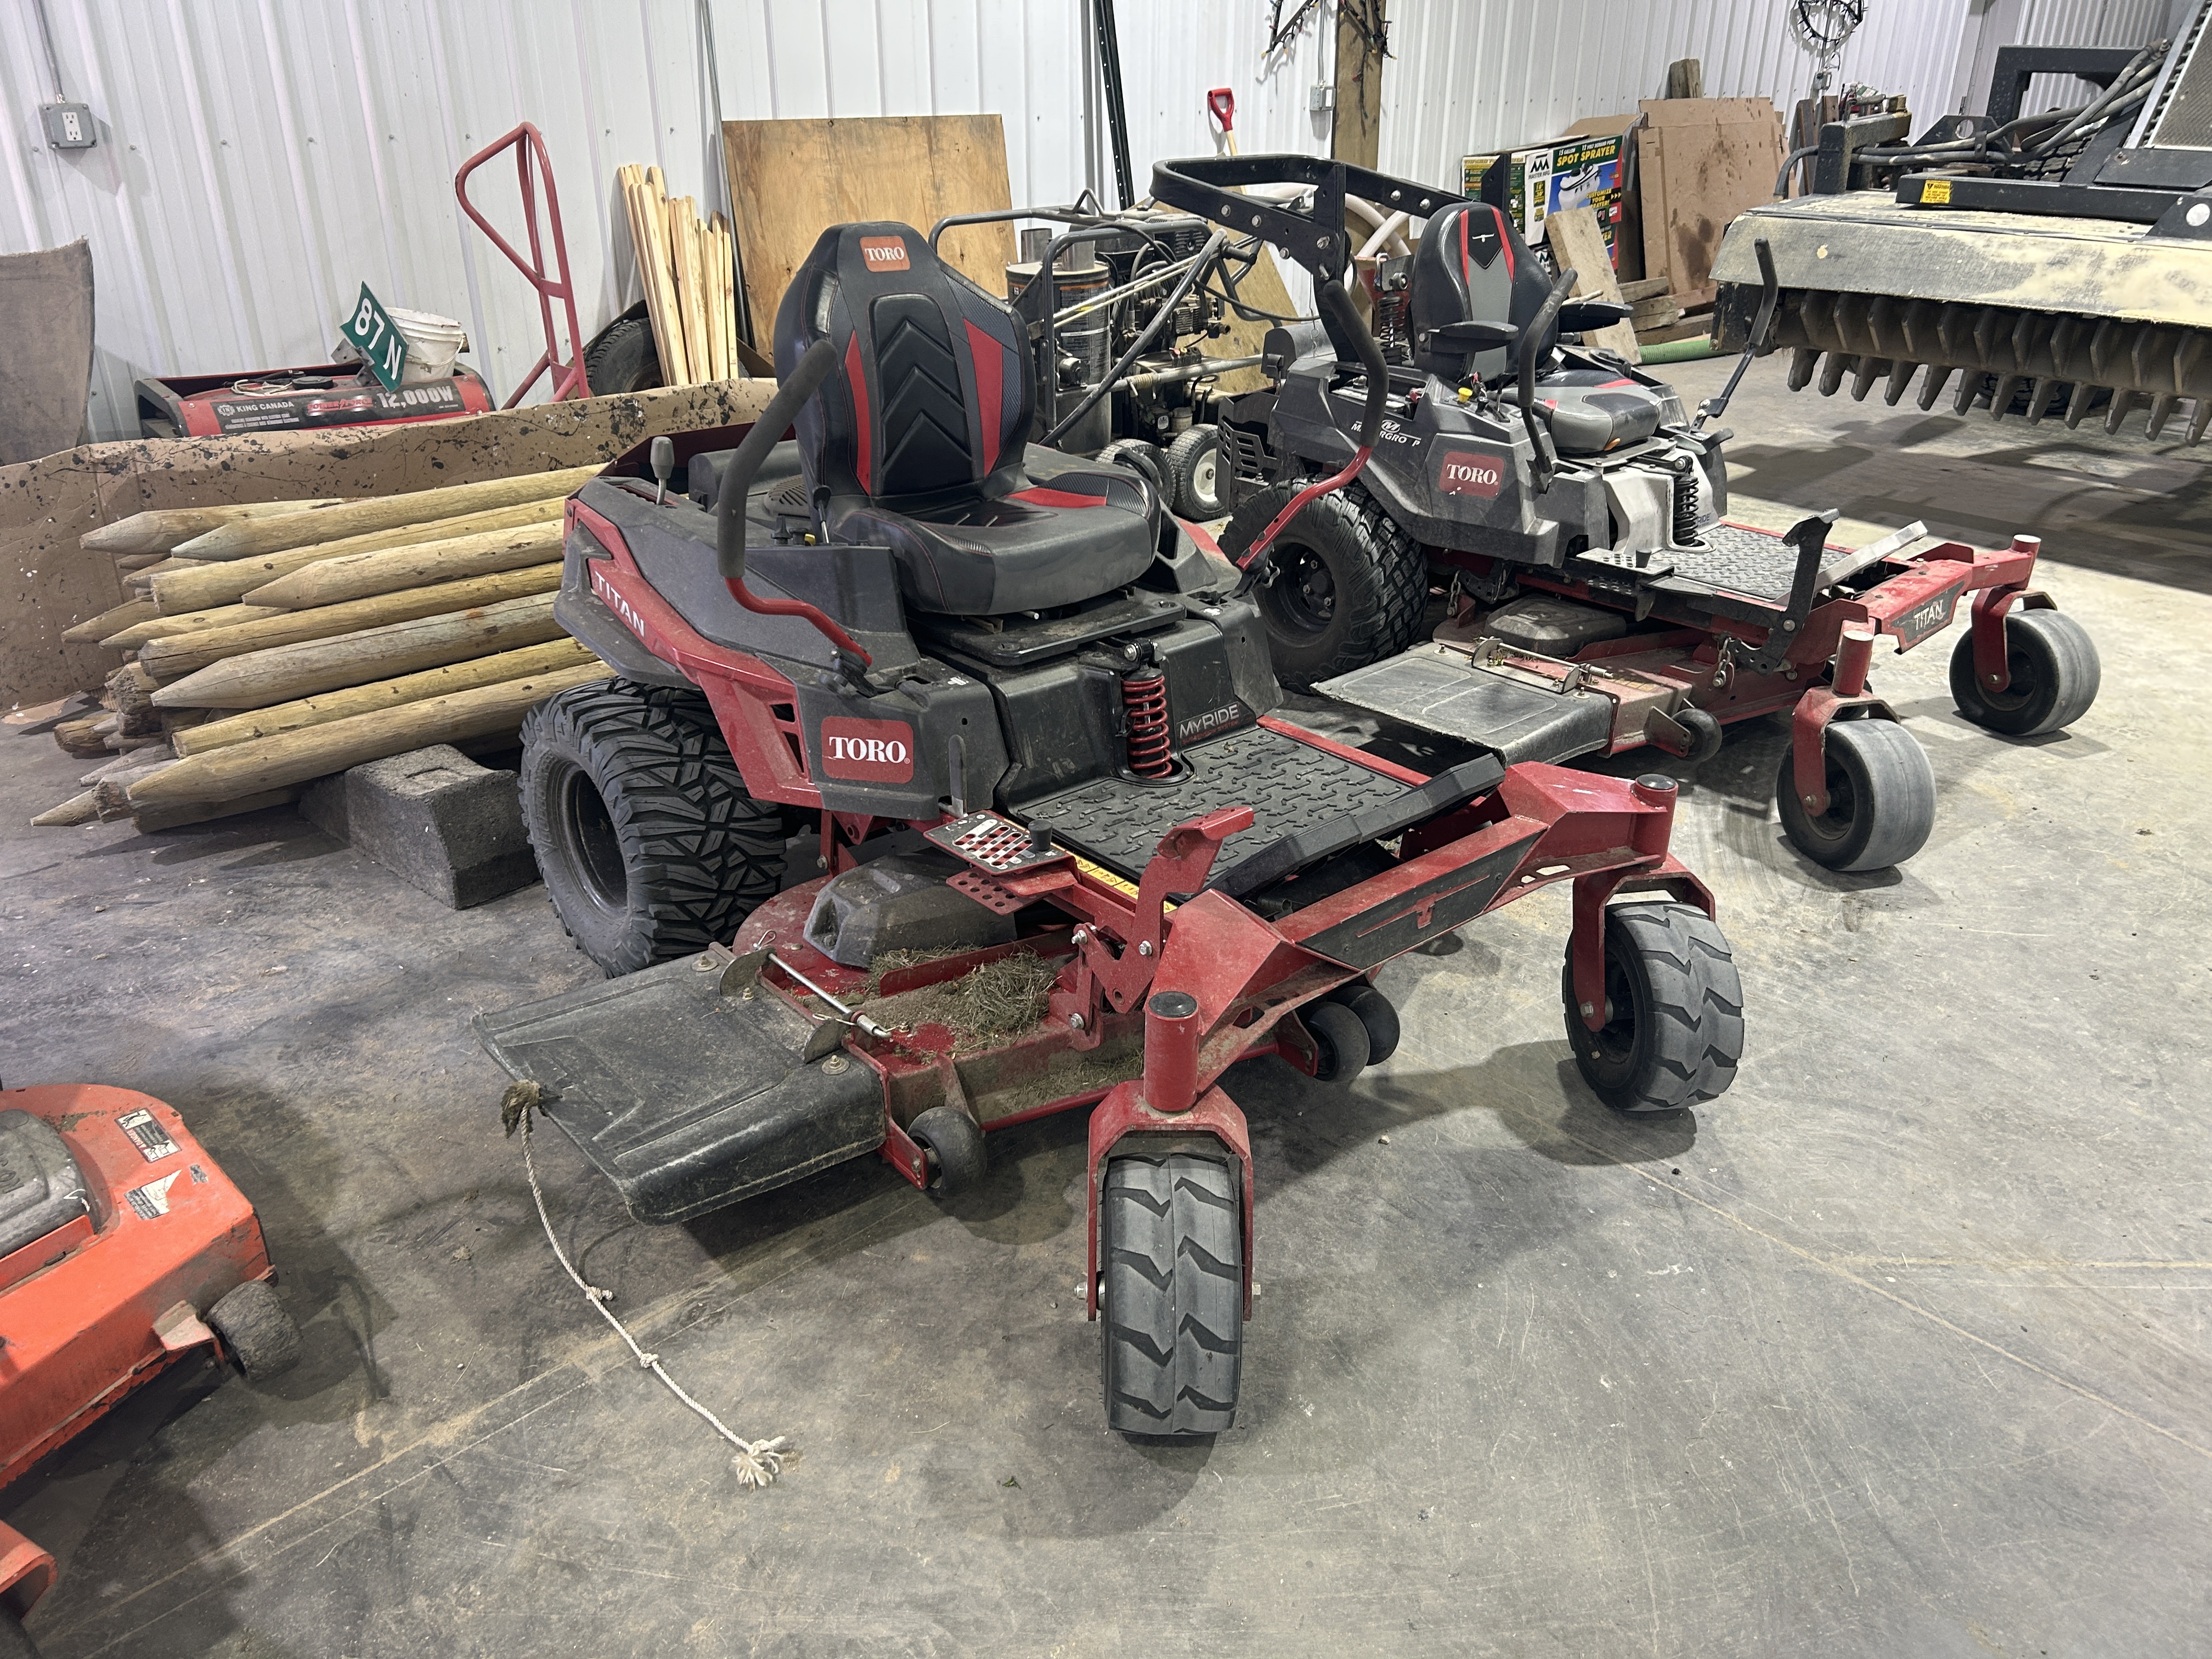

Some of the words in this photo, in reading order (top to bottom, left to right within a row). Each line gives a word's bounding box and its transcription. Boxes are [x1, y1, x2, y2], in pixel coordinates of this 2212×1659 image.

[1556, 153, 1579, 167] SPOT
[1580, 144, 1616, 161] SPRAYER
[1586, 188, 1612, 199] CUSTOMIZE
[1592, 195, 1605, 204] YOUR
[864, 246, 905, 262] TORO
[355, 298, 385, 350] 87
[383, 334, 402, 380] N
[260, 401, 295, 410] CANADA
[377, 386, 453, 408] 12,000W
[1446, 464, 1497, 485] TORO
[595, 571, 645, 638] TITAN
[1914, 600, 1944, 631] TITAN
[829, 736, 906, 764] TORO
